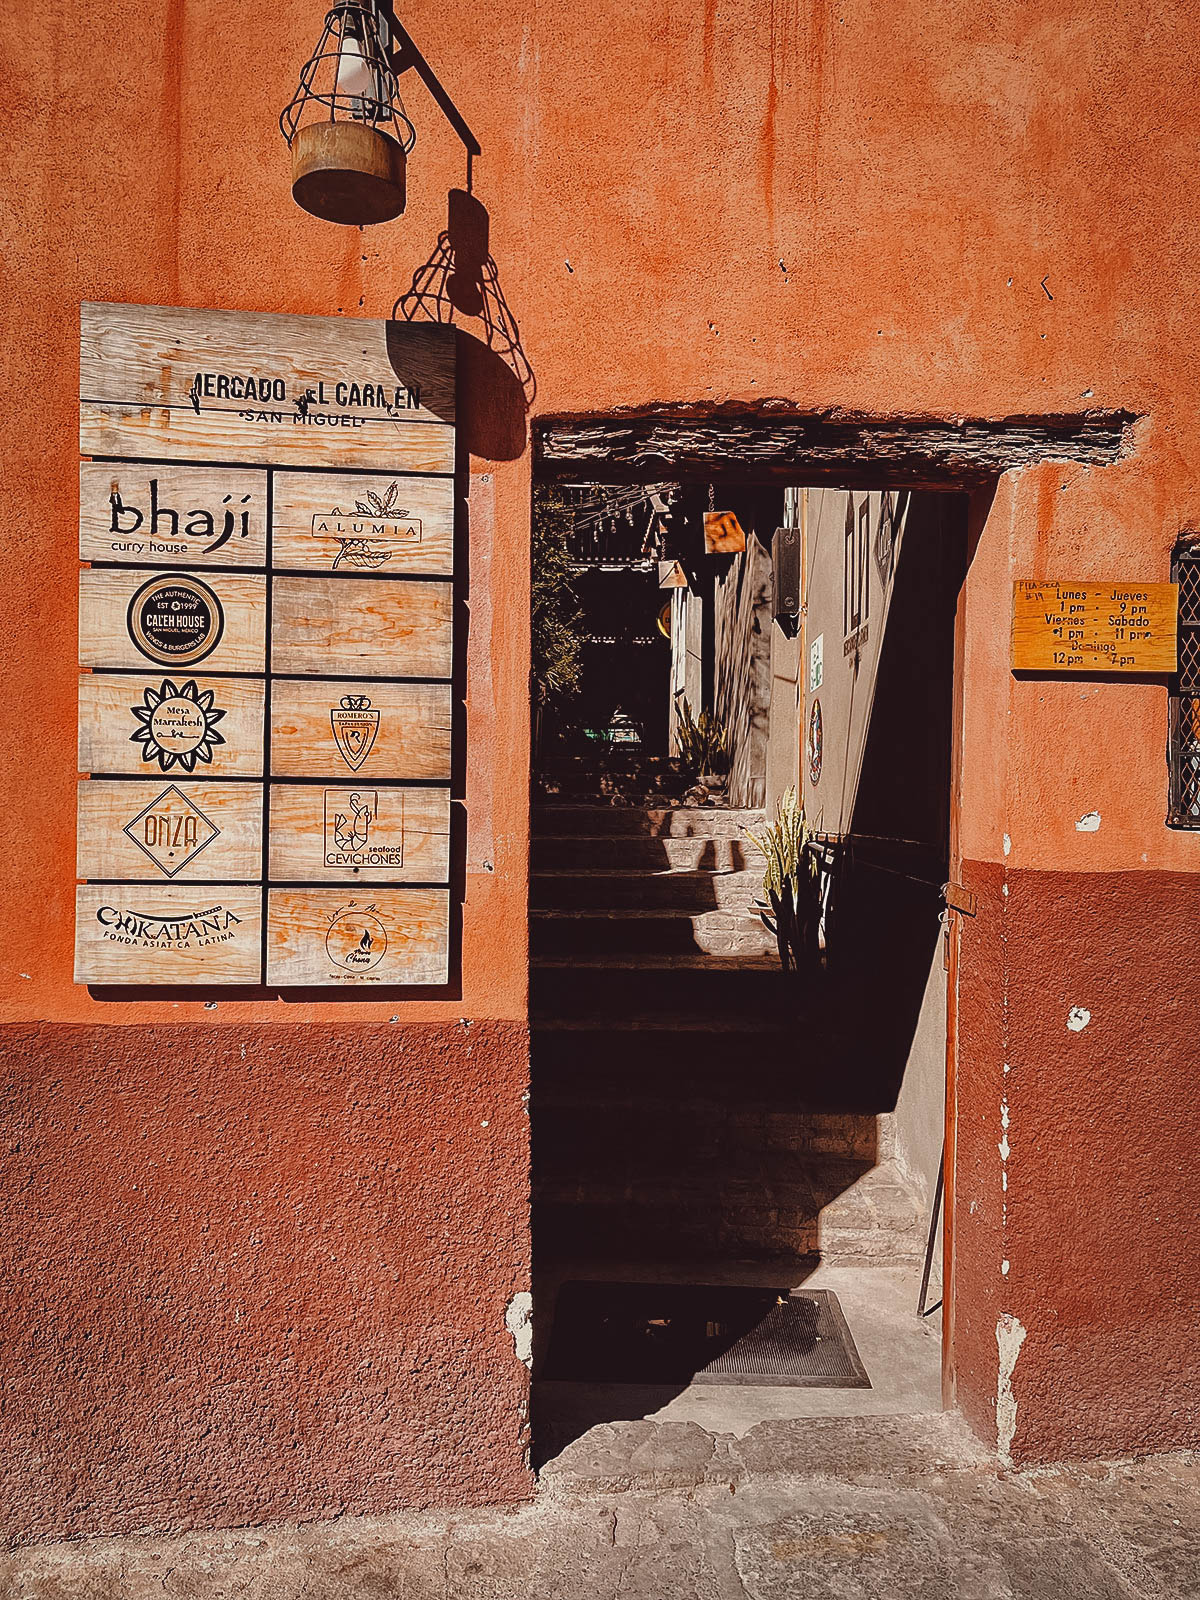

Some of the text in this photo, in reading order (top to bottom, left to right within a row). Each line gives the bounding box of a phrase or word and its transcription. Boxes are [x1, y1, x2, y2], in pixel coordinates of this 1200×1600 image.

[244, 410, 362, 428] SAN MIGUEL
[109, 478, 252, 554] bhaji
[317, 521, 417, 536] ALUMIA
[111, 540, 188, 554] curry house
[151, 590, 201, 605] THE AUTHENTIC
[1056, 587, 1087, 600] Lunes
[1110, 589, 1149, 601] Jueves
[180, 602, 198, 610] 1999
[1060, 600, 1147, 616] 1 pm 9 pm
[176, 615, 205, 628] HOUSE
[1044, 612, 1085, 626] Viernes
[1068, 629, 1085, 640] pm
[1053, 652, 1135, 667] 12 pm 7 pm
[166, 706, 190, 715] Mesa
[153, 714, 203, 727] Marrakesh
[144, 814, 198, 848] ONZA
[368, 845, 401, 853] seafood
[326, 853, 401, 865] CEVICHONES
[96, 906, 243, 941] CHIKATANA
[103, 930, 236, 949] FONDA ASIATCA LATINA
